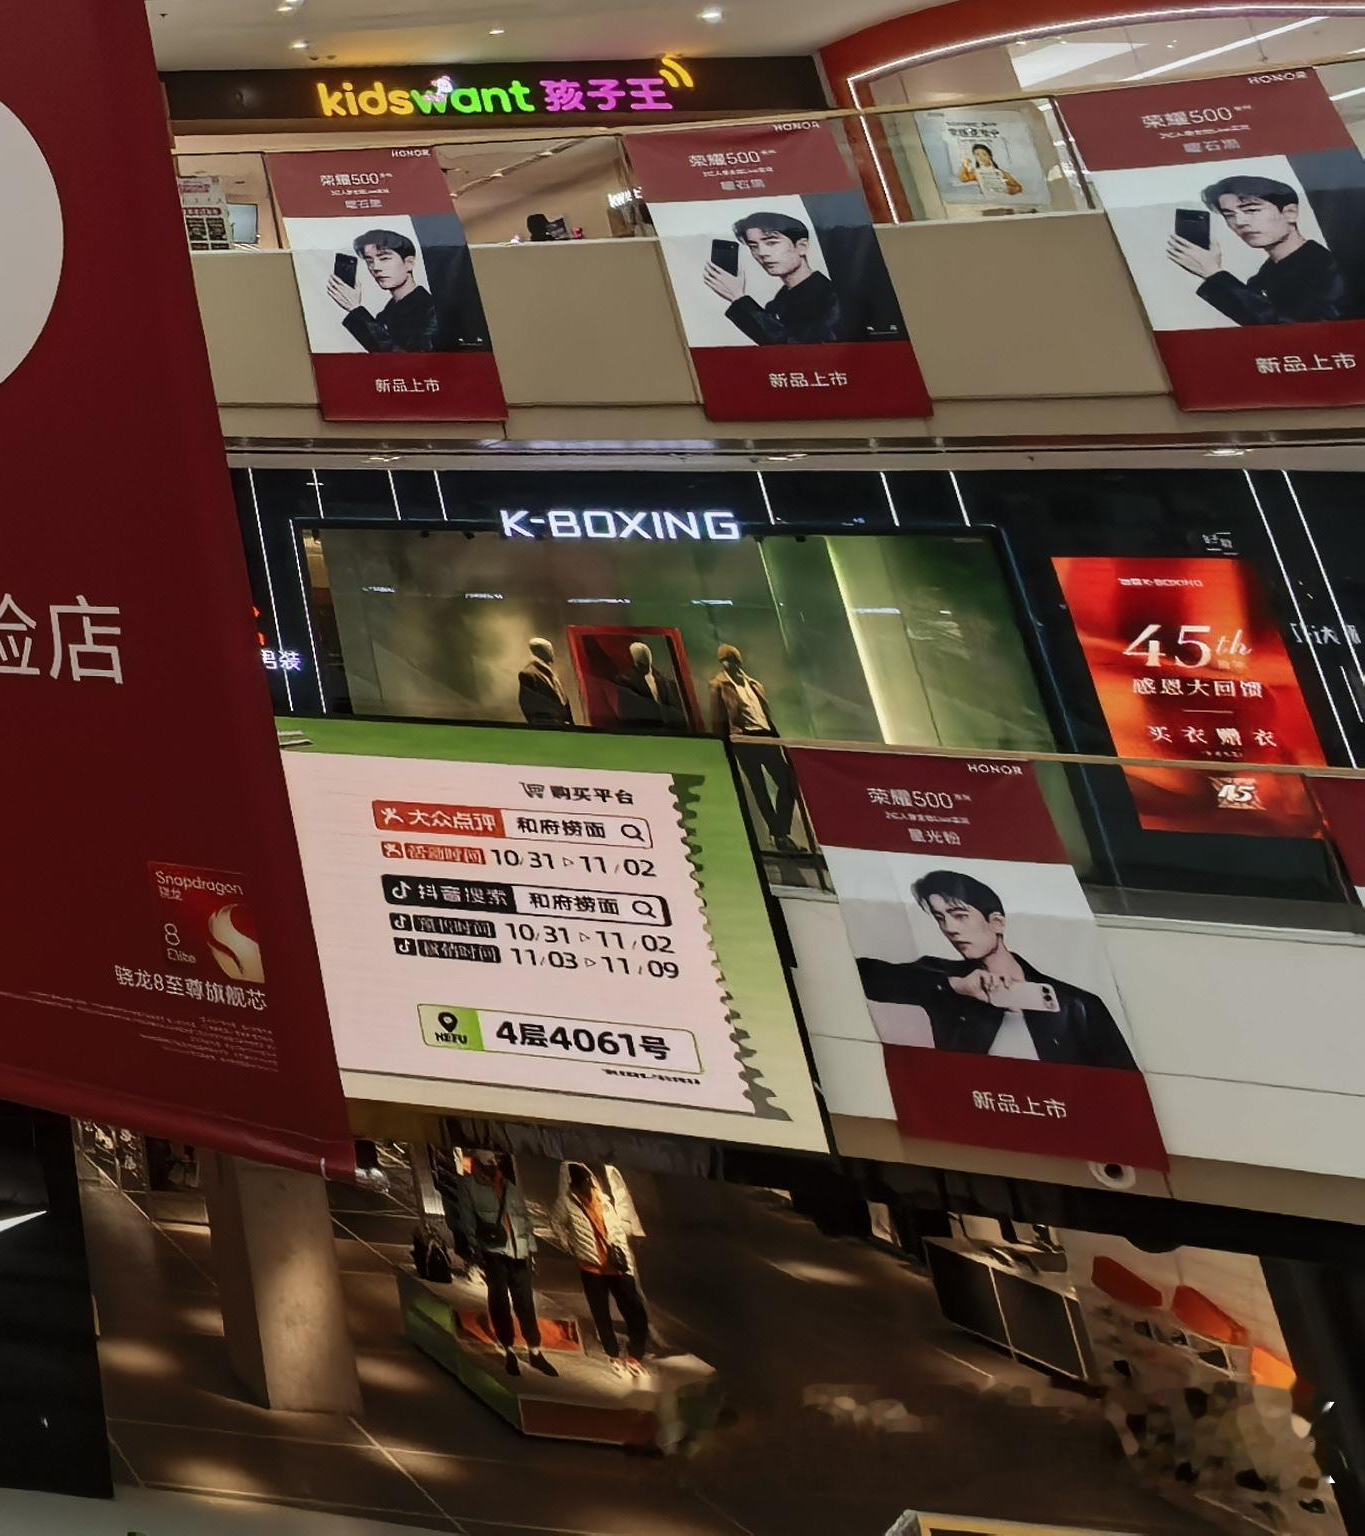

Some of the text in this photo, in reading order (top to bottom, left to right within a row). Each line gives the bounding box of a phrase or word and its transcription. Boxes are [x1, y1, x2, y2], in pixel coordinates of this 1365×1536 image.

[1247, 71, 1308, 86] HONOR
[317, 77, 674, 118] kidswant 孩子王
[772, 120, 820, 132] HONOR
[1142, 105, 1233, 129] 荣耀500
[391, 148, 431, 158] HONOR
[689, 149, 761, 167] 荣耀500
[320, 172, 379, 187] 荣耀500
[1255, 352, 1357, 375] 新品上市
[375, 377, 441, 395] 新品上市
[769, 371, 848, 389] 新品上市
[499, 509, 742, 543] K-BOXING
[1122, 623, 1253, 669] 45th
[1132, 677, 1264, 700] 感恩大回馈
[1148, 725, 1278, 749] 买衣赠衣
[967, 763, 1023, 776] HONOR
[550, 784, 635, 805] 购买平台
[866, 787, 954, 809] 荣耀500
[408, 808, 607, 840] 大众点评 和府捞面
[155, 870, 244, 896] Snapdragon
[417, 883, 621, 916] 抖音搜索 和府捞面
[164, 923, 181, 946] 8
[166, 948, 197, 964] Elite
[114, 964, 268, 1011] 骁龙8至尊旗舰芯
[435, 1030, 469, 1045] HEFU
[496, 1019, 672, 1061] 4层4061号
[972, 1091, 1067, 1119] 新品上市
